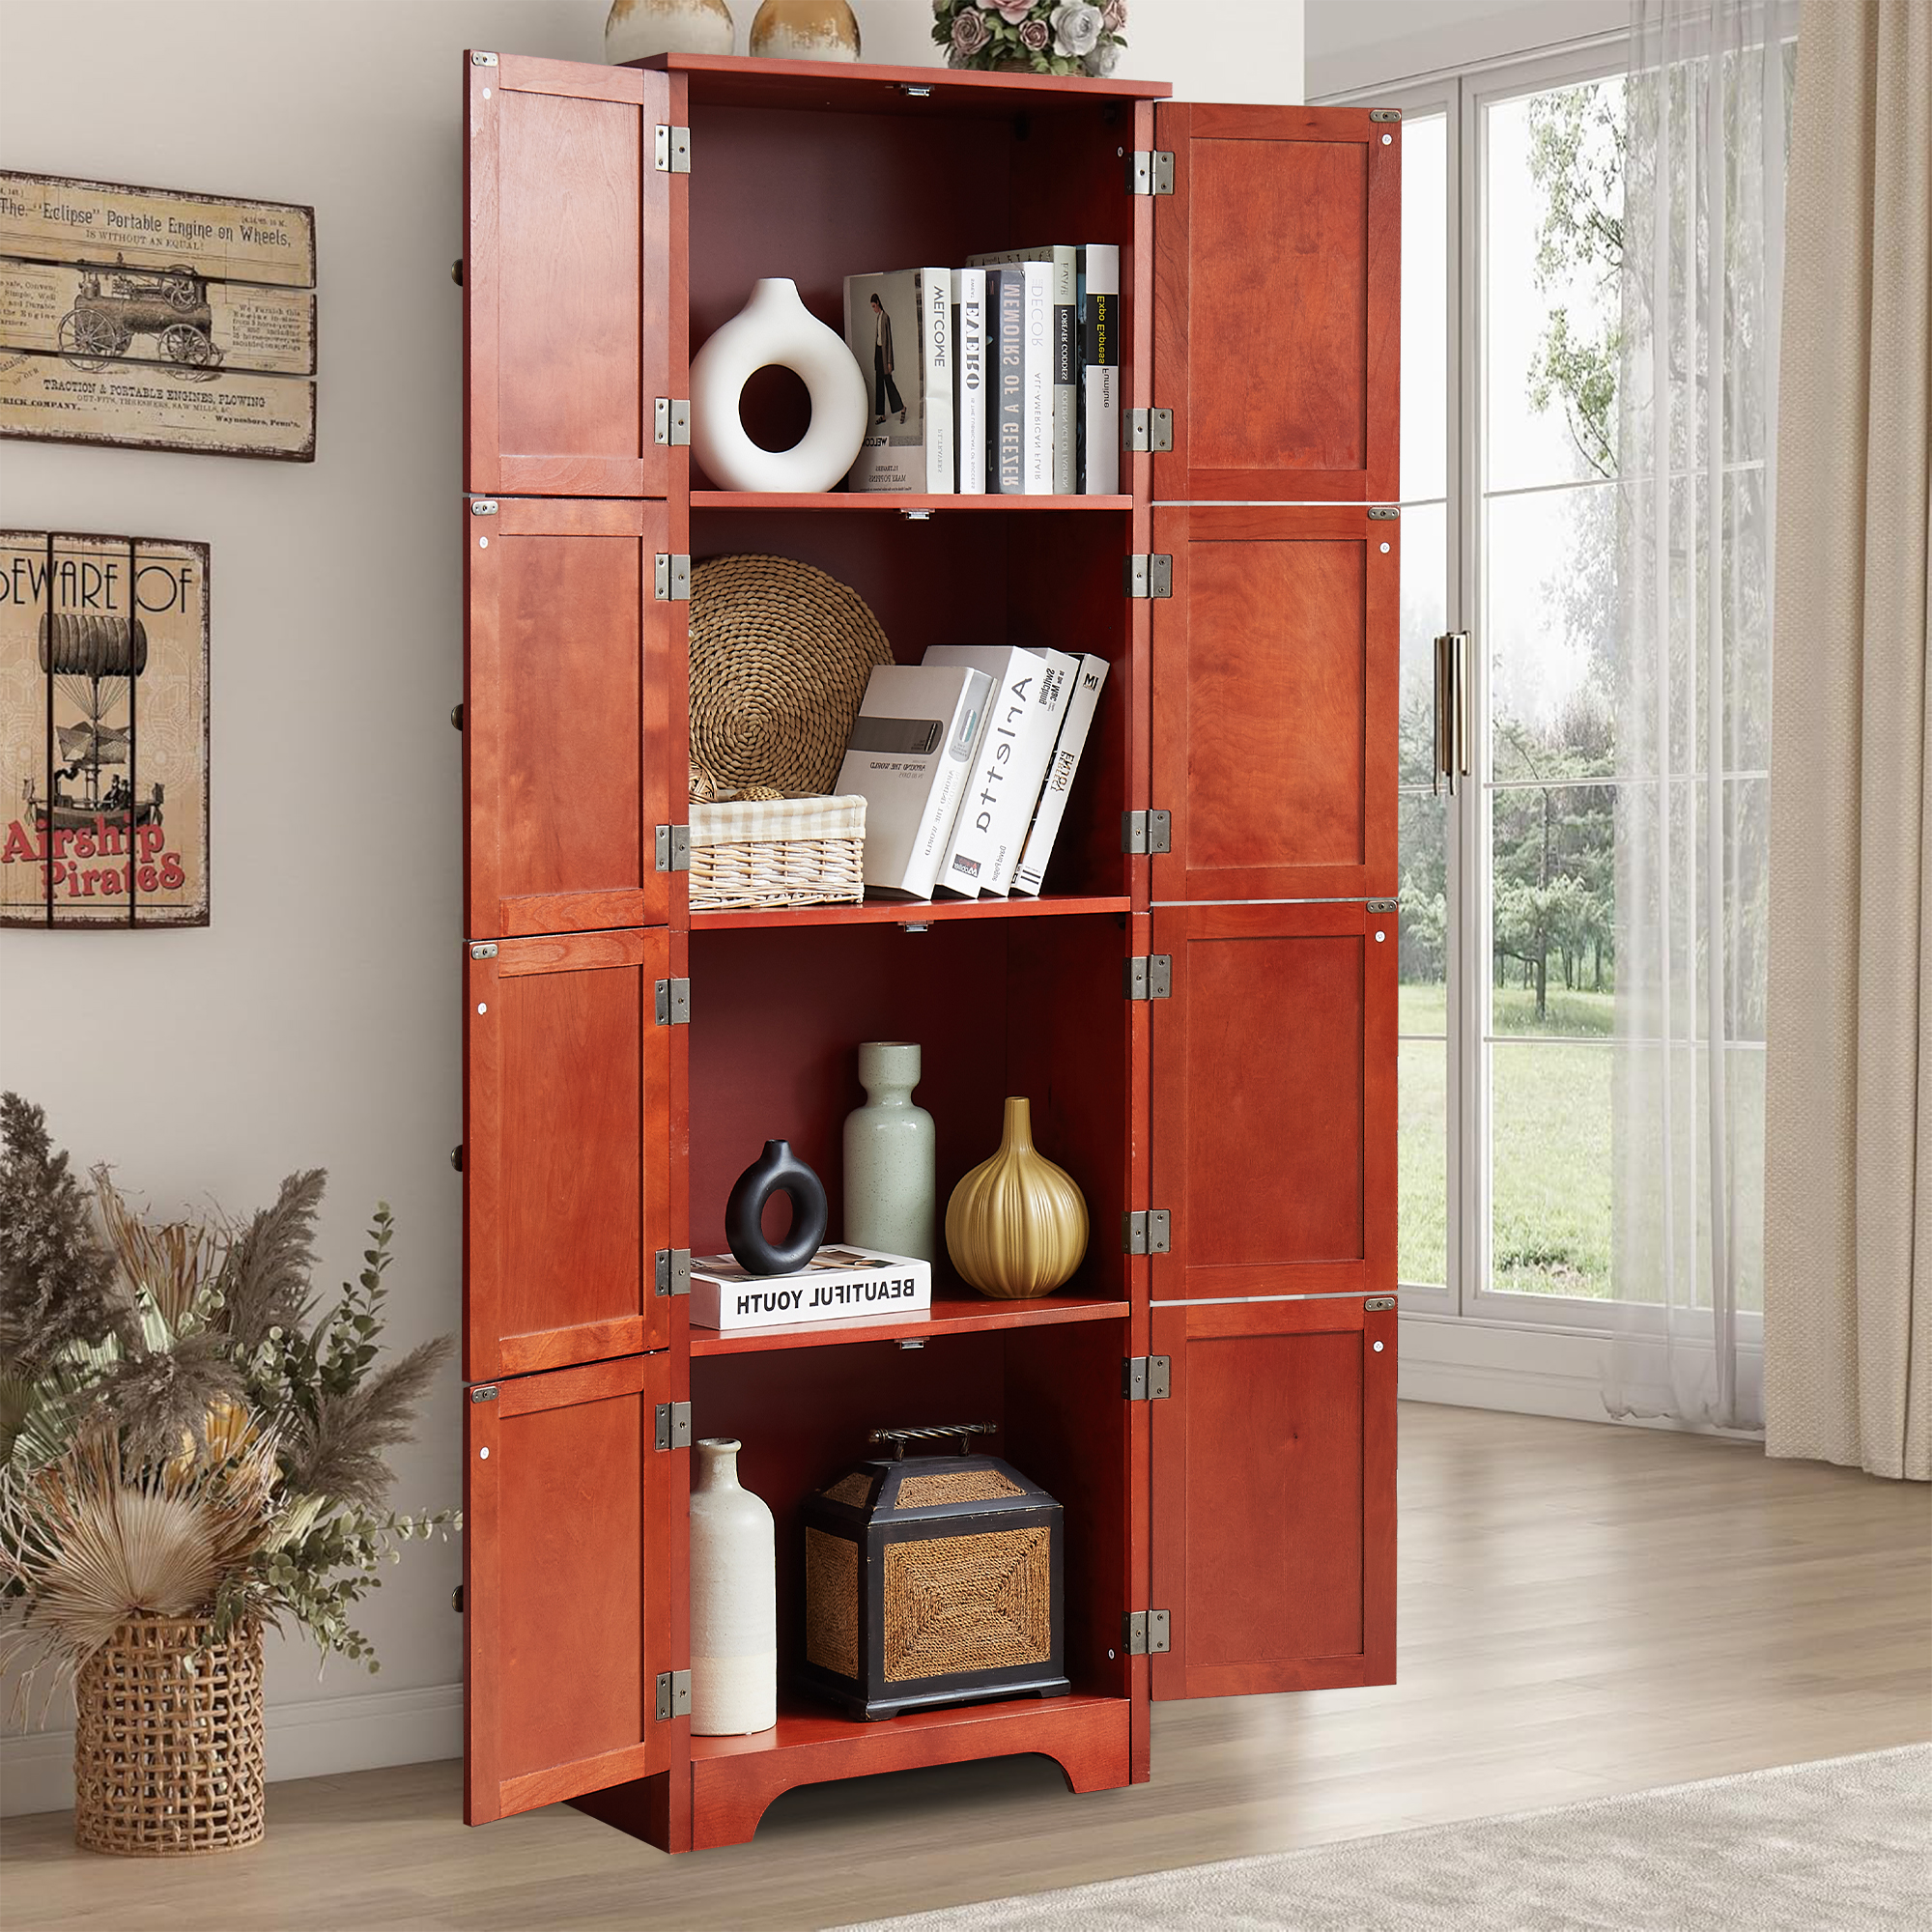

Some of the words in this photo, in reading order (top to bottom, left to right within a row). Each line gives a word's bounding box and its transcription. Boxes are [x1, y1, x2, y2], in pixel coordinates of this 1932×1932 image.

[99, 231, 147, 244] WITHOUT
[151, 238, 163, 246] AN
[107, 210, 162, 232] Portable
[169, 216, 213, 240] Engine
[218, 226, 233, 241] on
[43, 379, 97, 394] TRACTION
[99, 384, 107, 394] &
[110, 384, 163, 400] PORTABLE
[218, 394, 266, 408] PLOWING
[136, 566, 192, 613] OF
[1, 813, 165, 864] Airship
